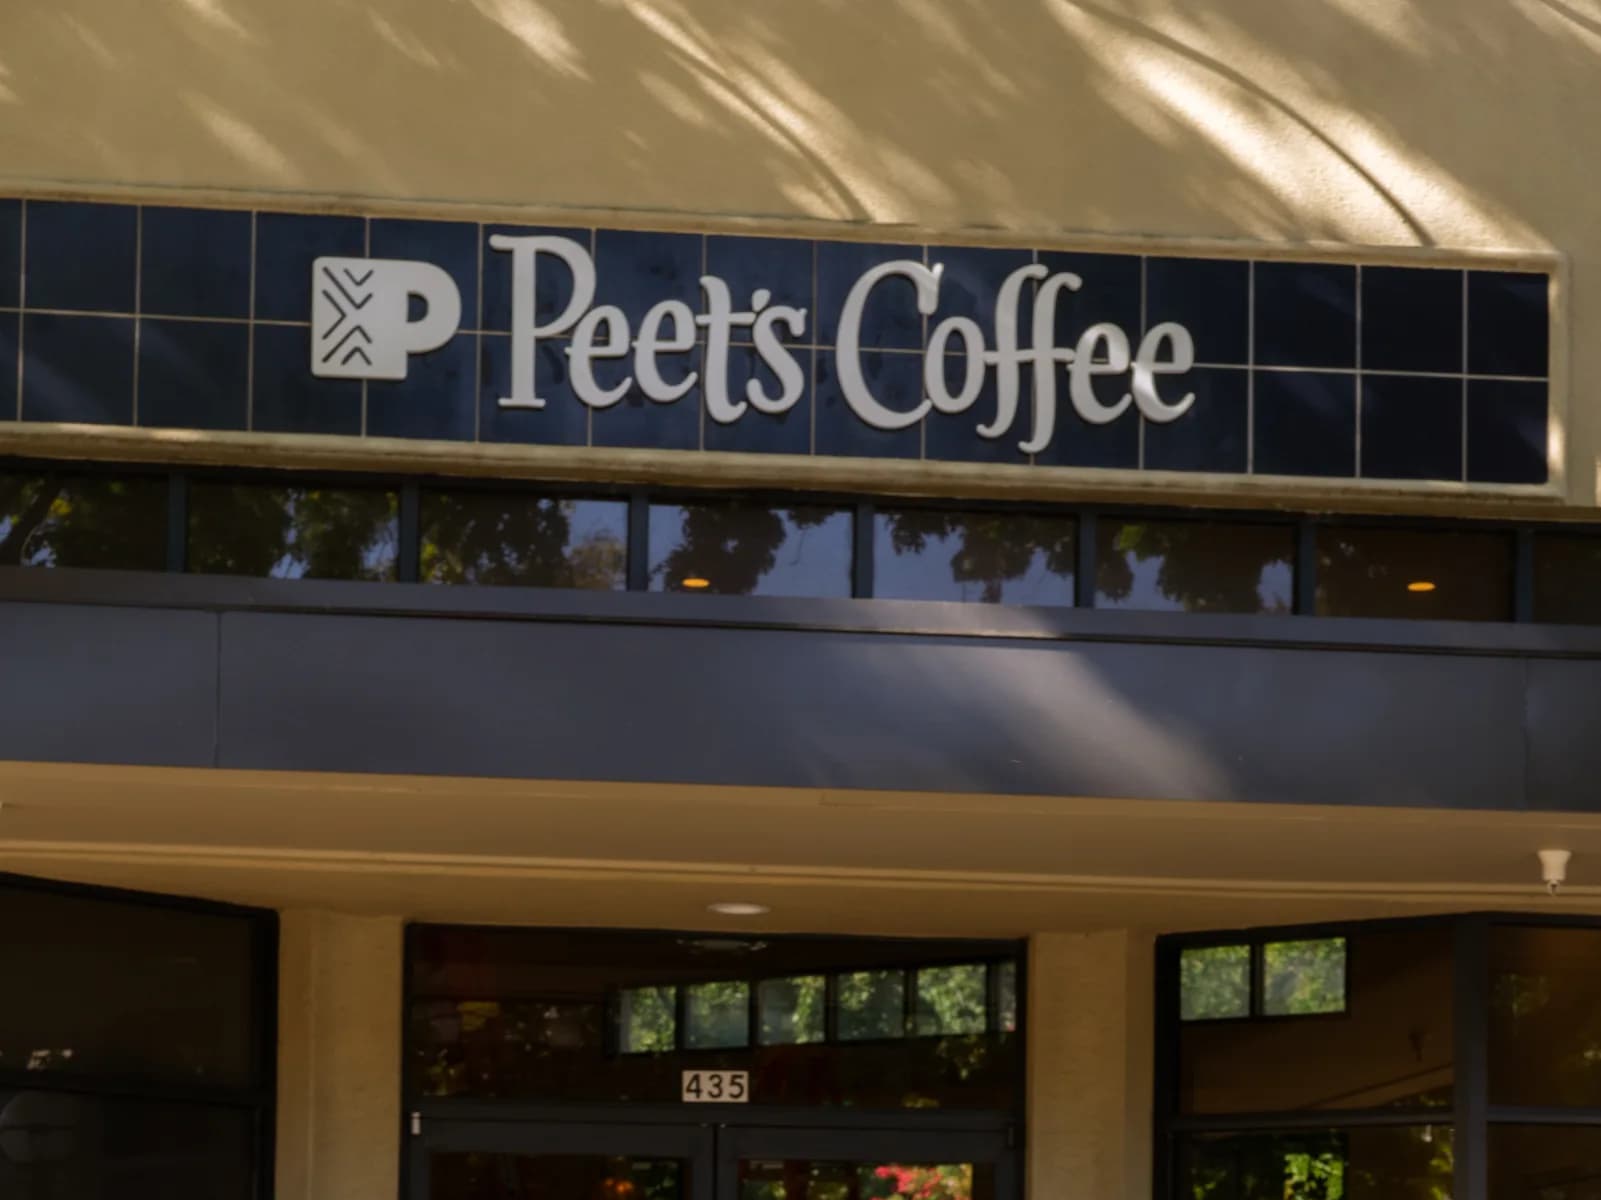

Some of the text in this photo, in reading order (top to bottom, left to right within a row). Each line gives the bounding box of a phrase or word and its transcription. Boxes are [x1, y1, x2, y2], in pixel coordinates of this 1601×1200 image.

[489, 233, 806, 424] Peet's
[836, 260, 1195, 454] Coffee
[685, 1073, 745, 1099] 435
